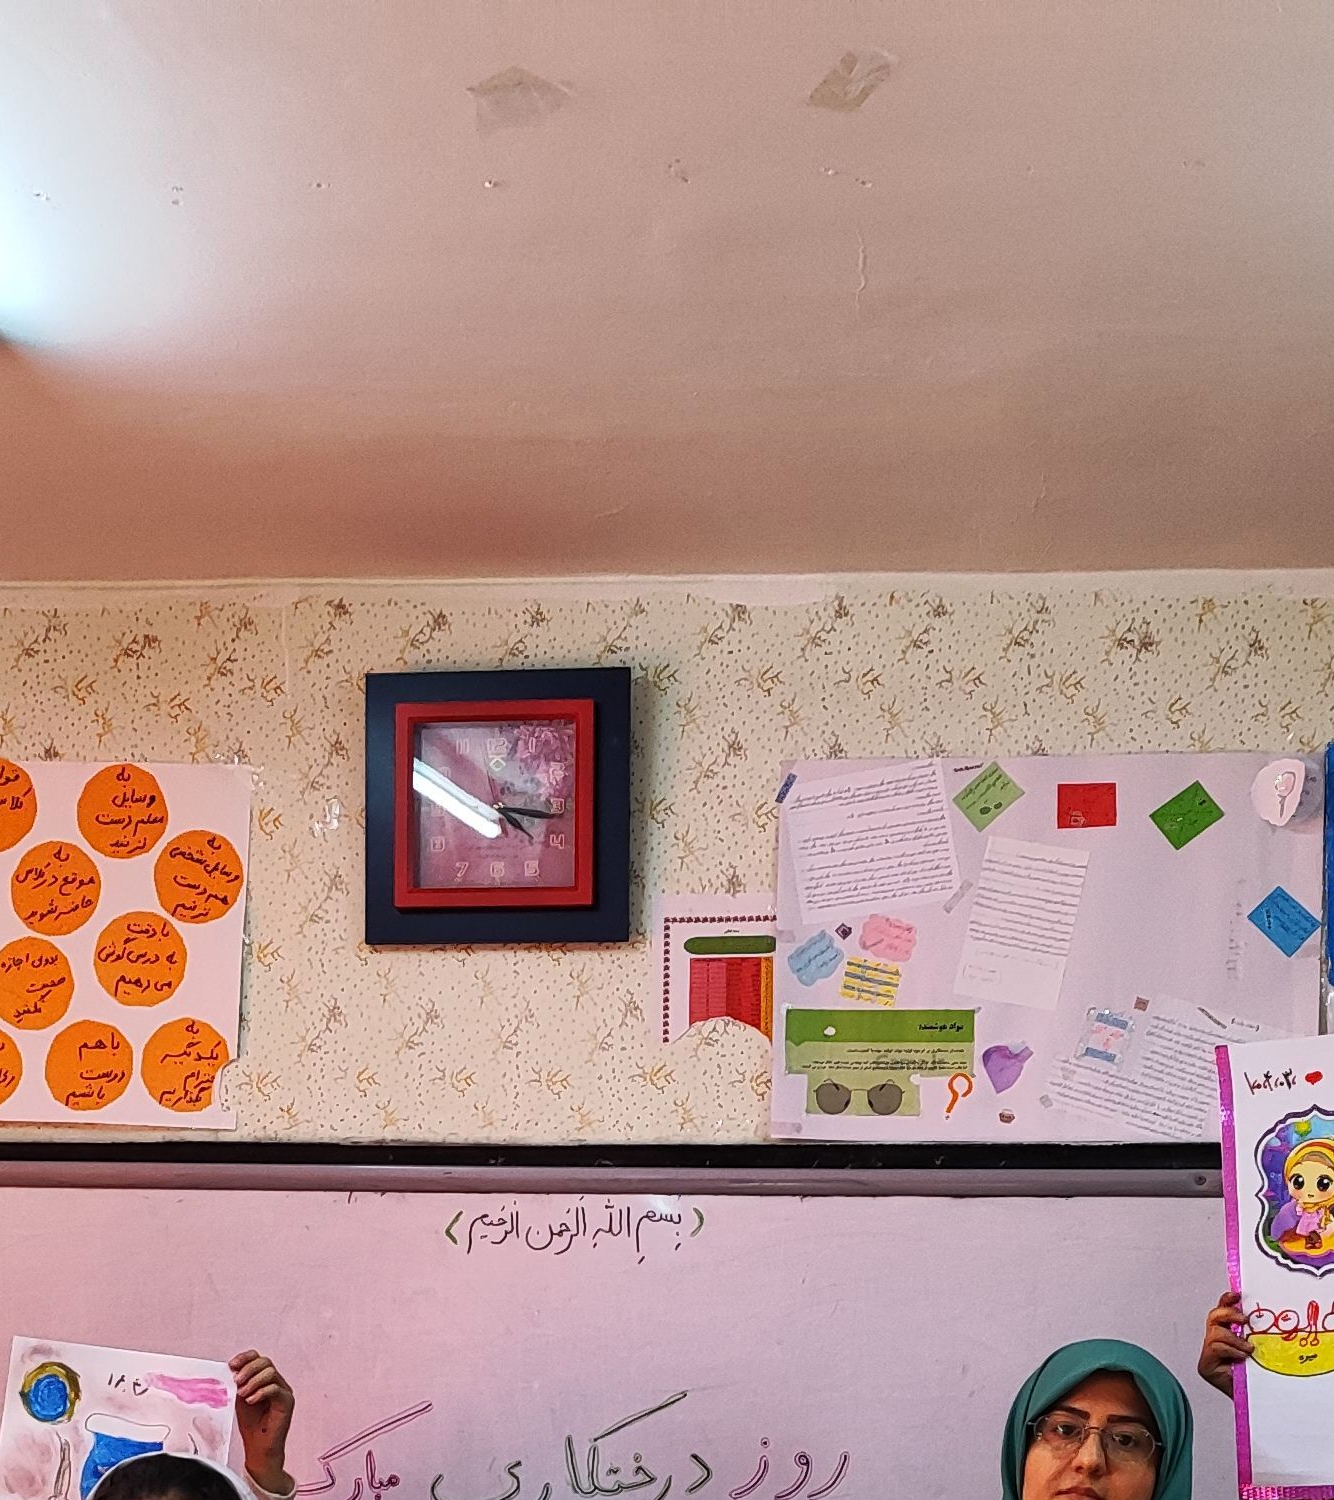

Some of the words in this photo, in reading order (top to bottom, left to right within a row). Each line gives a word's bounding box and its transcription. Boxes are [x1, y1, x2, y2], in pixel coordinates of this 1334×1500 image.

[115, 766, 132, 789] به
[111, 787, 157, 809] وسایل
[95, 813, 133, 829] دست
[133, 813, 165, 837] معلم
[206, 835, 222, 855] به
[53, 845, 70, 869] به
[15, 861, 52, 883] کلاس
[31, 874, 59, 890] در
[203, 861, 241, 884] وسایل
[126, 922, 157, 939] دقت
[0, 952, 30, 973] اجازه
[125, 949, 160, 965] درس
[165, 950, 178, 971] به
[25, 975, 67, 994] صحبت
[153, 978, 172, 992] می
[185, 1020, 200, 1040] به
[78, 1039, 108, 1061] هم
[111, 1032, 121, 1057] با
[79, 1069, 126, 1084] دوست
